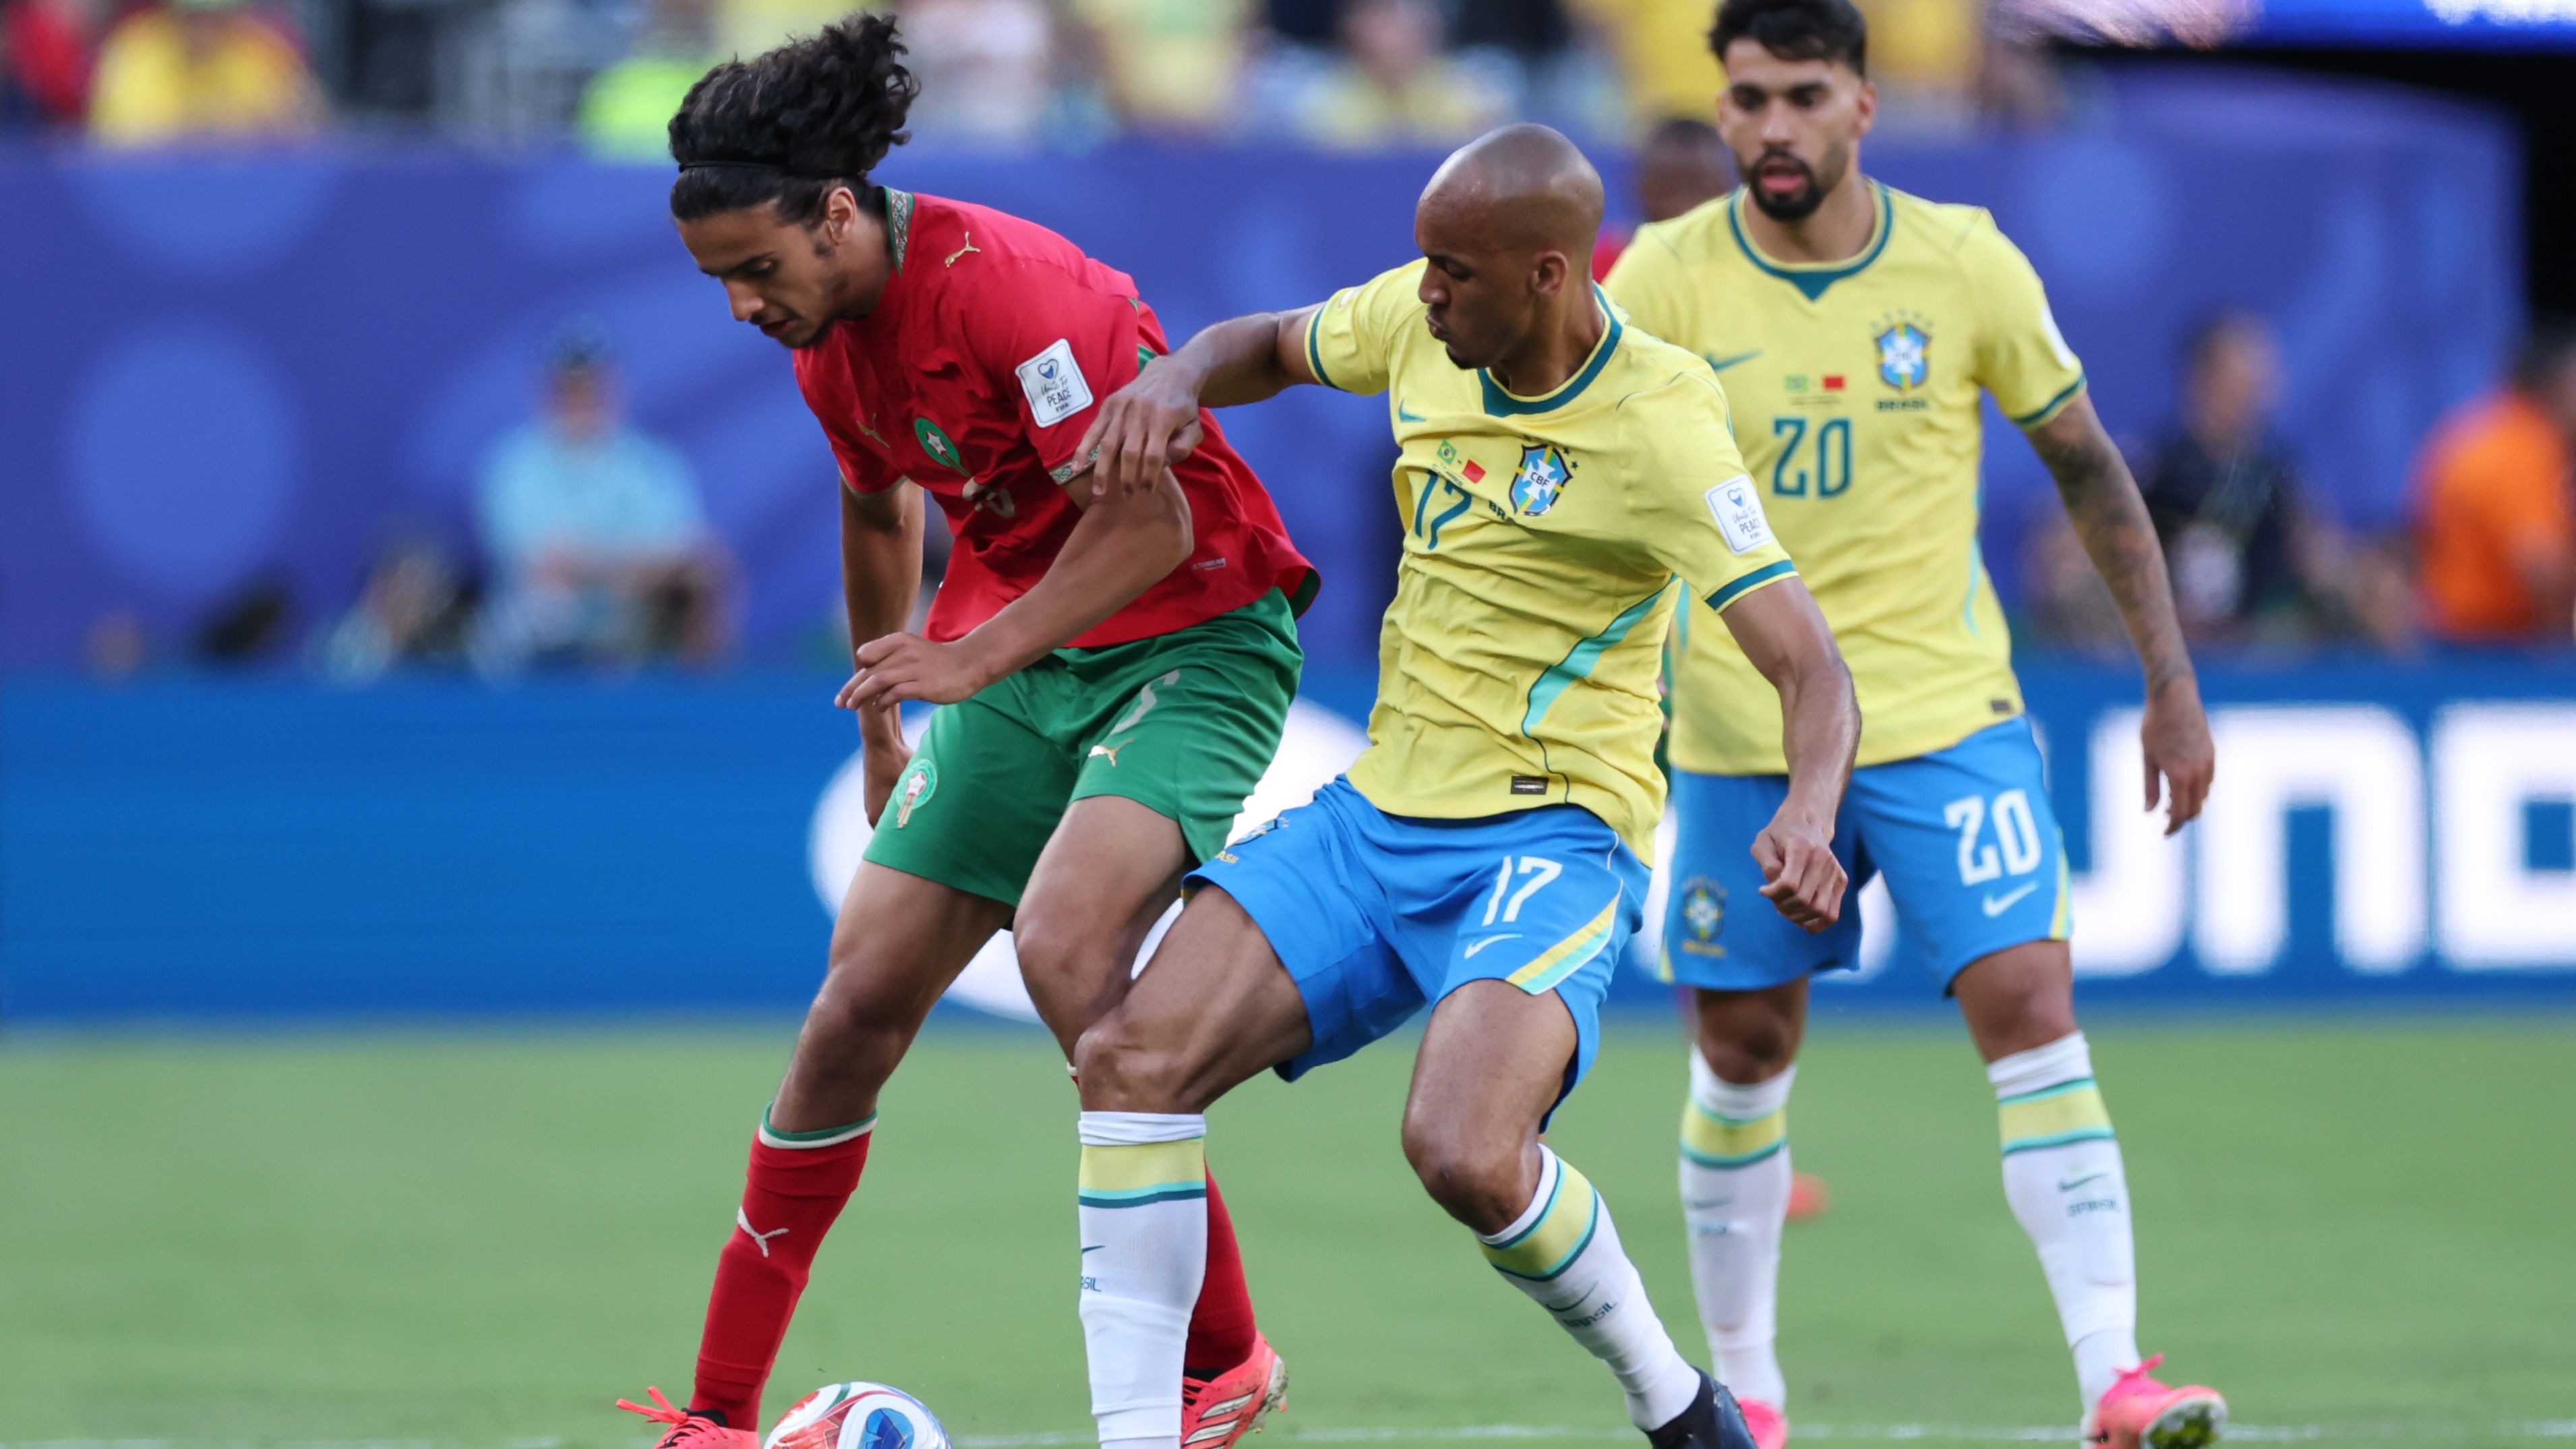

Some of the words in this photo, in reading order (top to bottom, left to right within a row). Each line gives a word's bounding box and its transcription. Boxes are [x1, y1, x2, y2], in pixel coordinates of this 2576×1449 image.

[1046, 386, 1072, 407] PEACE
[1530, 471, 1550, 487] CBF
[1772, 417, 1852, 498] 20
[1414, 469, 1472, 550] 17
[1944, 788, 2042, 887] 20
[1481, 854, 1563, 927] 17
